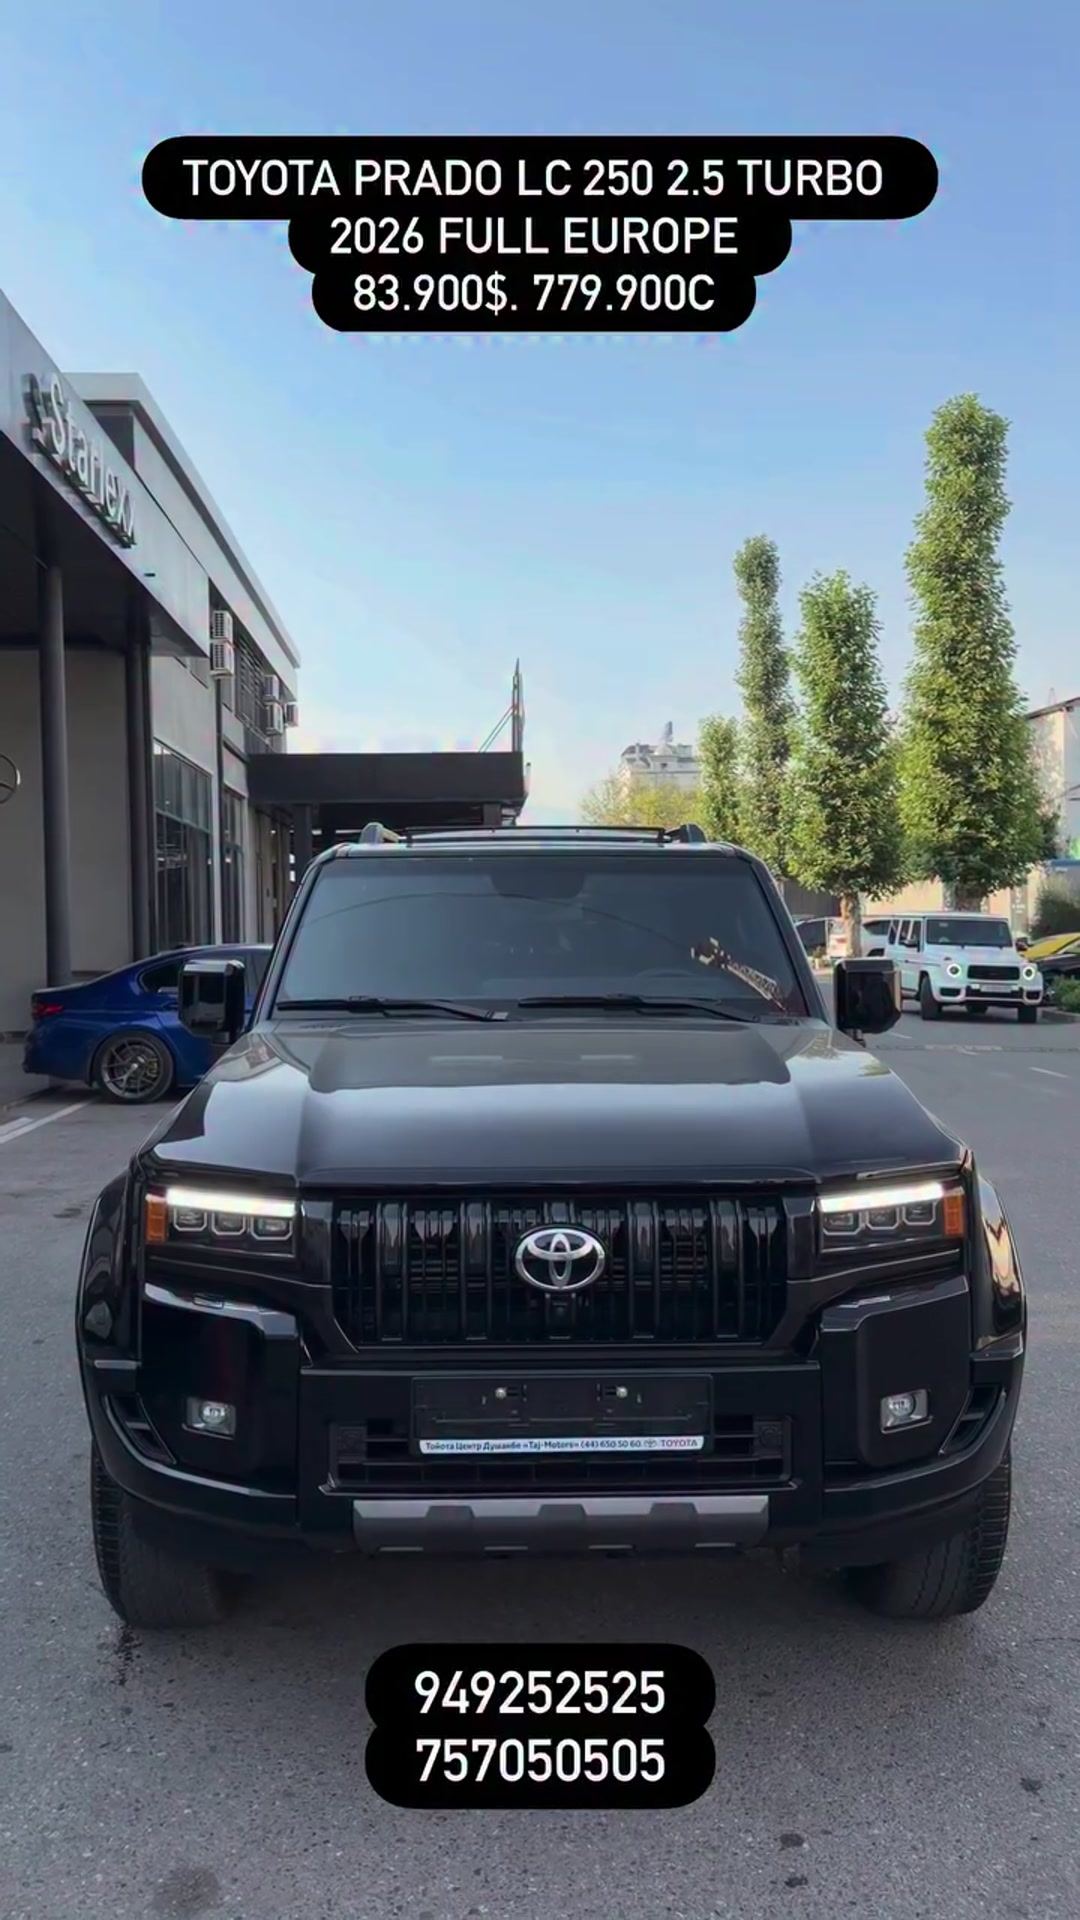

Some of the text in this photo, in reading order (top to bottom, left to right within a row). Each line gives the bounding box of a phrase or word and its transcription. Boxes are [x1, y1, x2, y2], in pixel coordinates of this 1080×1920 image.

[455, 1442, 481, 1452] Центр
[482, 1440, 522, 1451] Душанбе
[580, 1439, 599, 1449] (44)
[600, 1439, 617, 1449] 650
[617, 1439, 629, 1449] 50
[661, 1438, 698, 1447] TOYOTA
